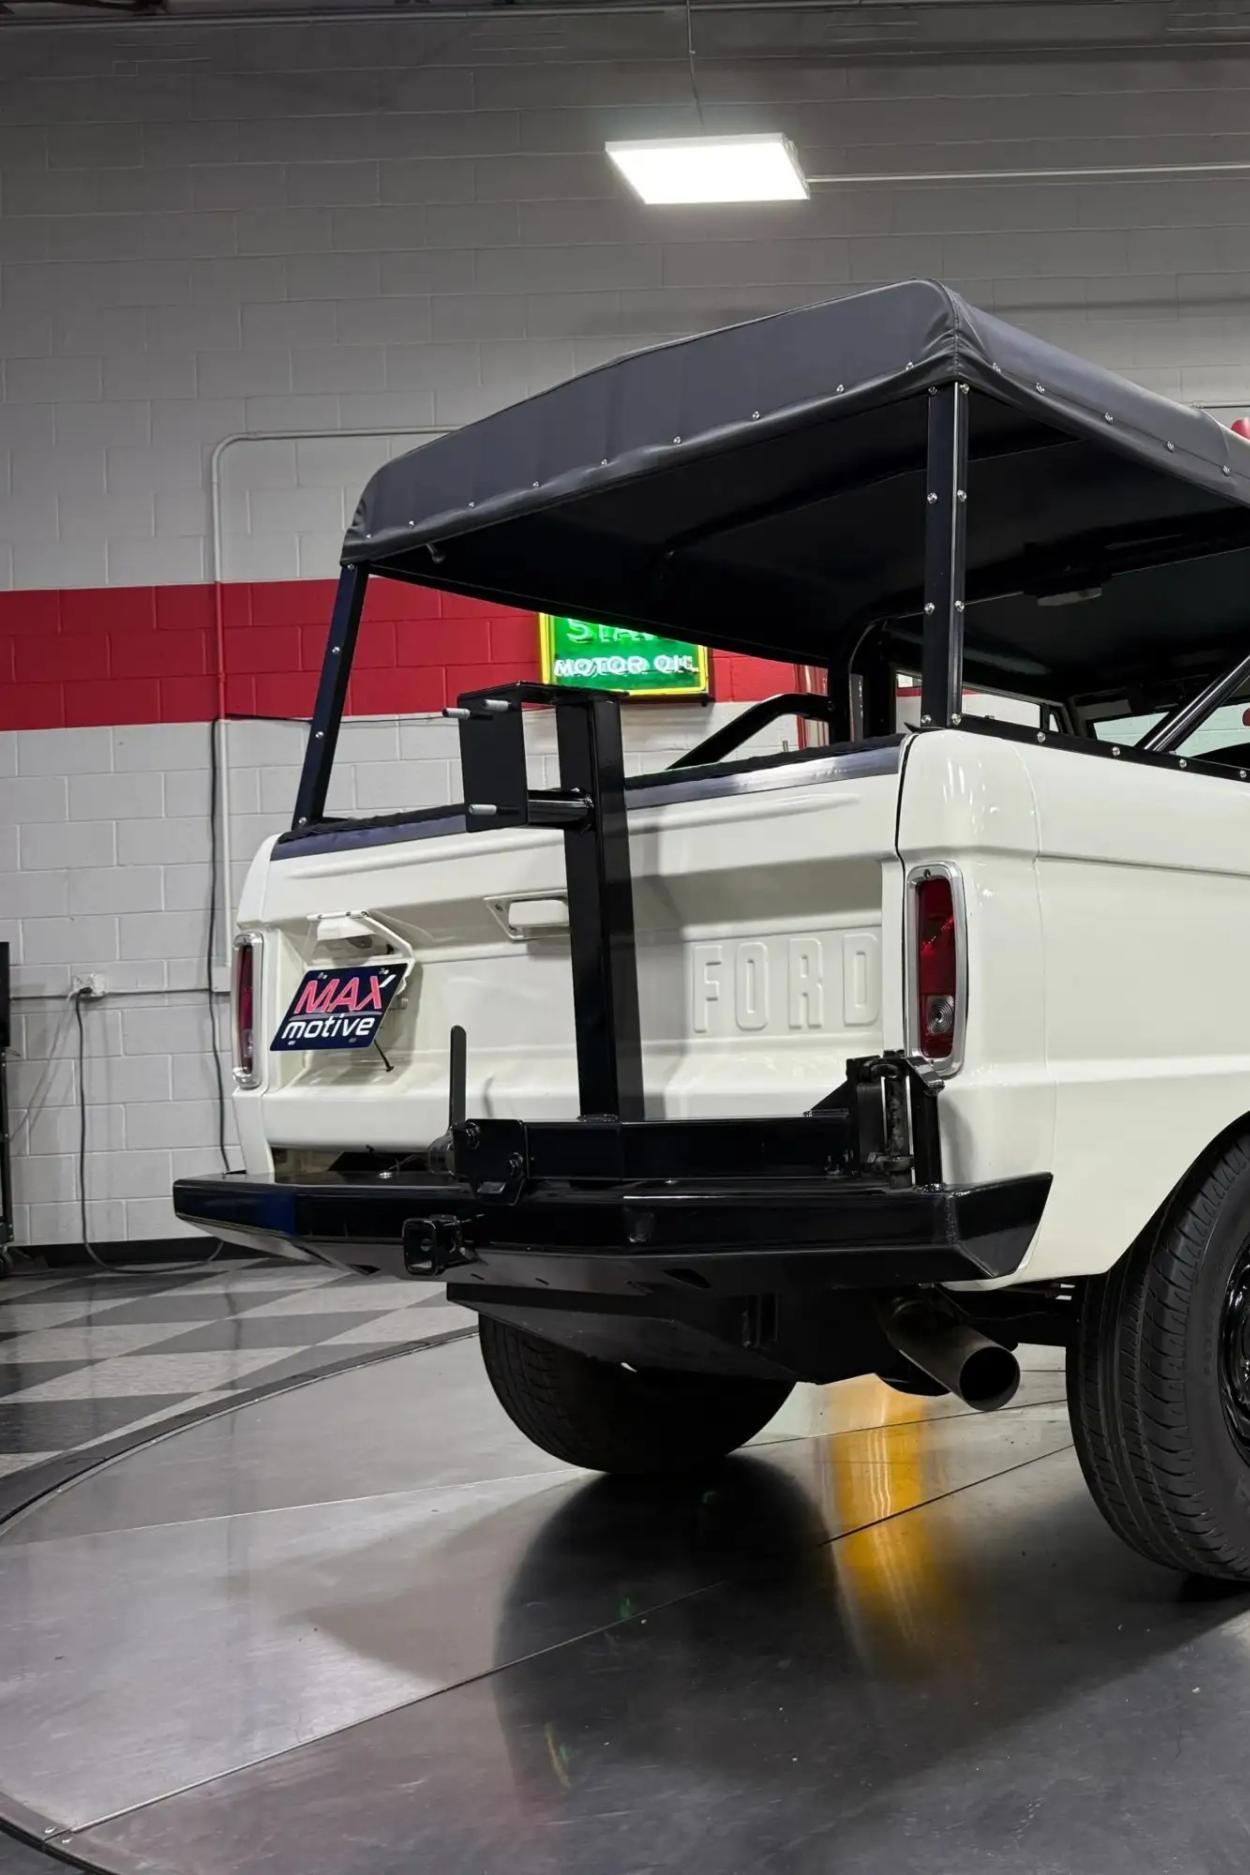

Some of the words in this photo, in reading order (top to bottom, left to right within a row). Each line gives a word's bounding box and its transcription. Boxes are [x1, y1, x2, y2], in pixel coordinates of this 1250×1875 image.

[554, 656, 649, 678] MOTOR
[653, 655, 699, 674] OIL
[293, 974, 397, 1014] MAX
[694, 933, 879, 1034] FORD
[281, 1013, 376, 1039] motive
